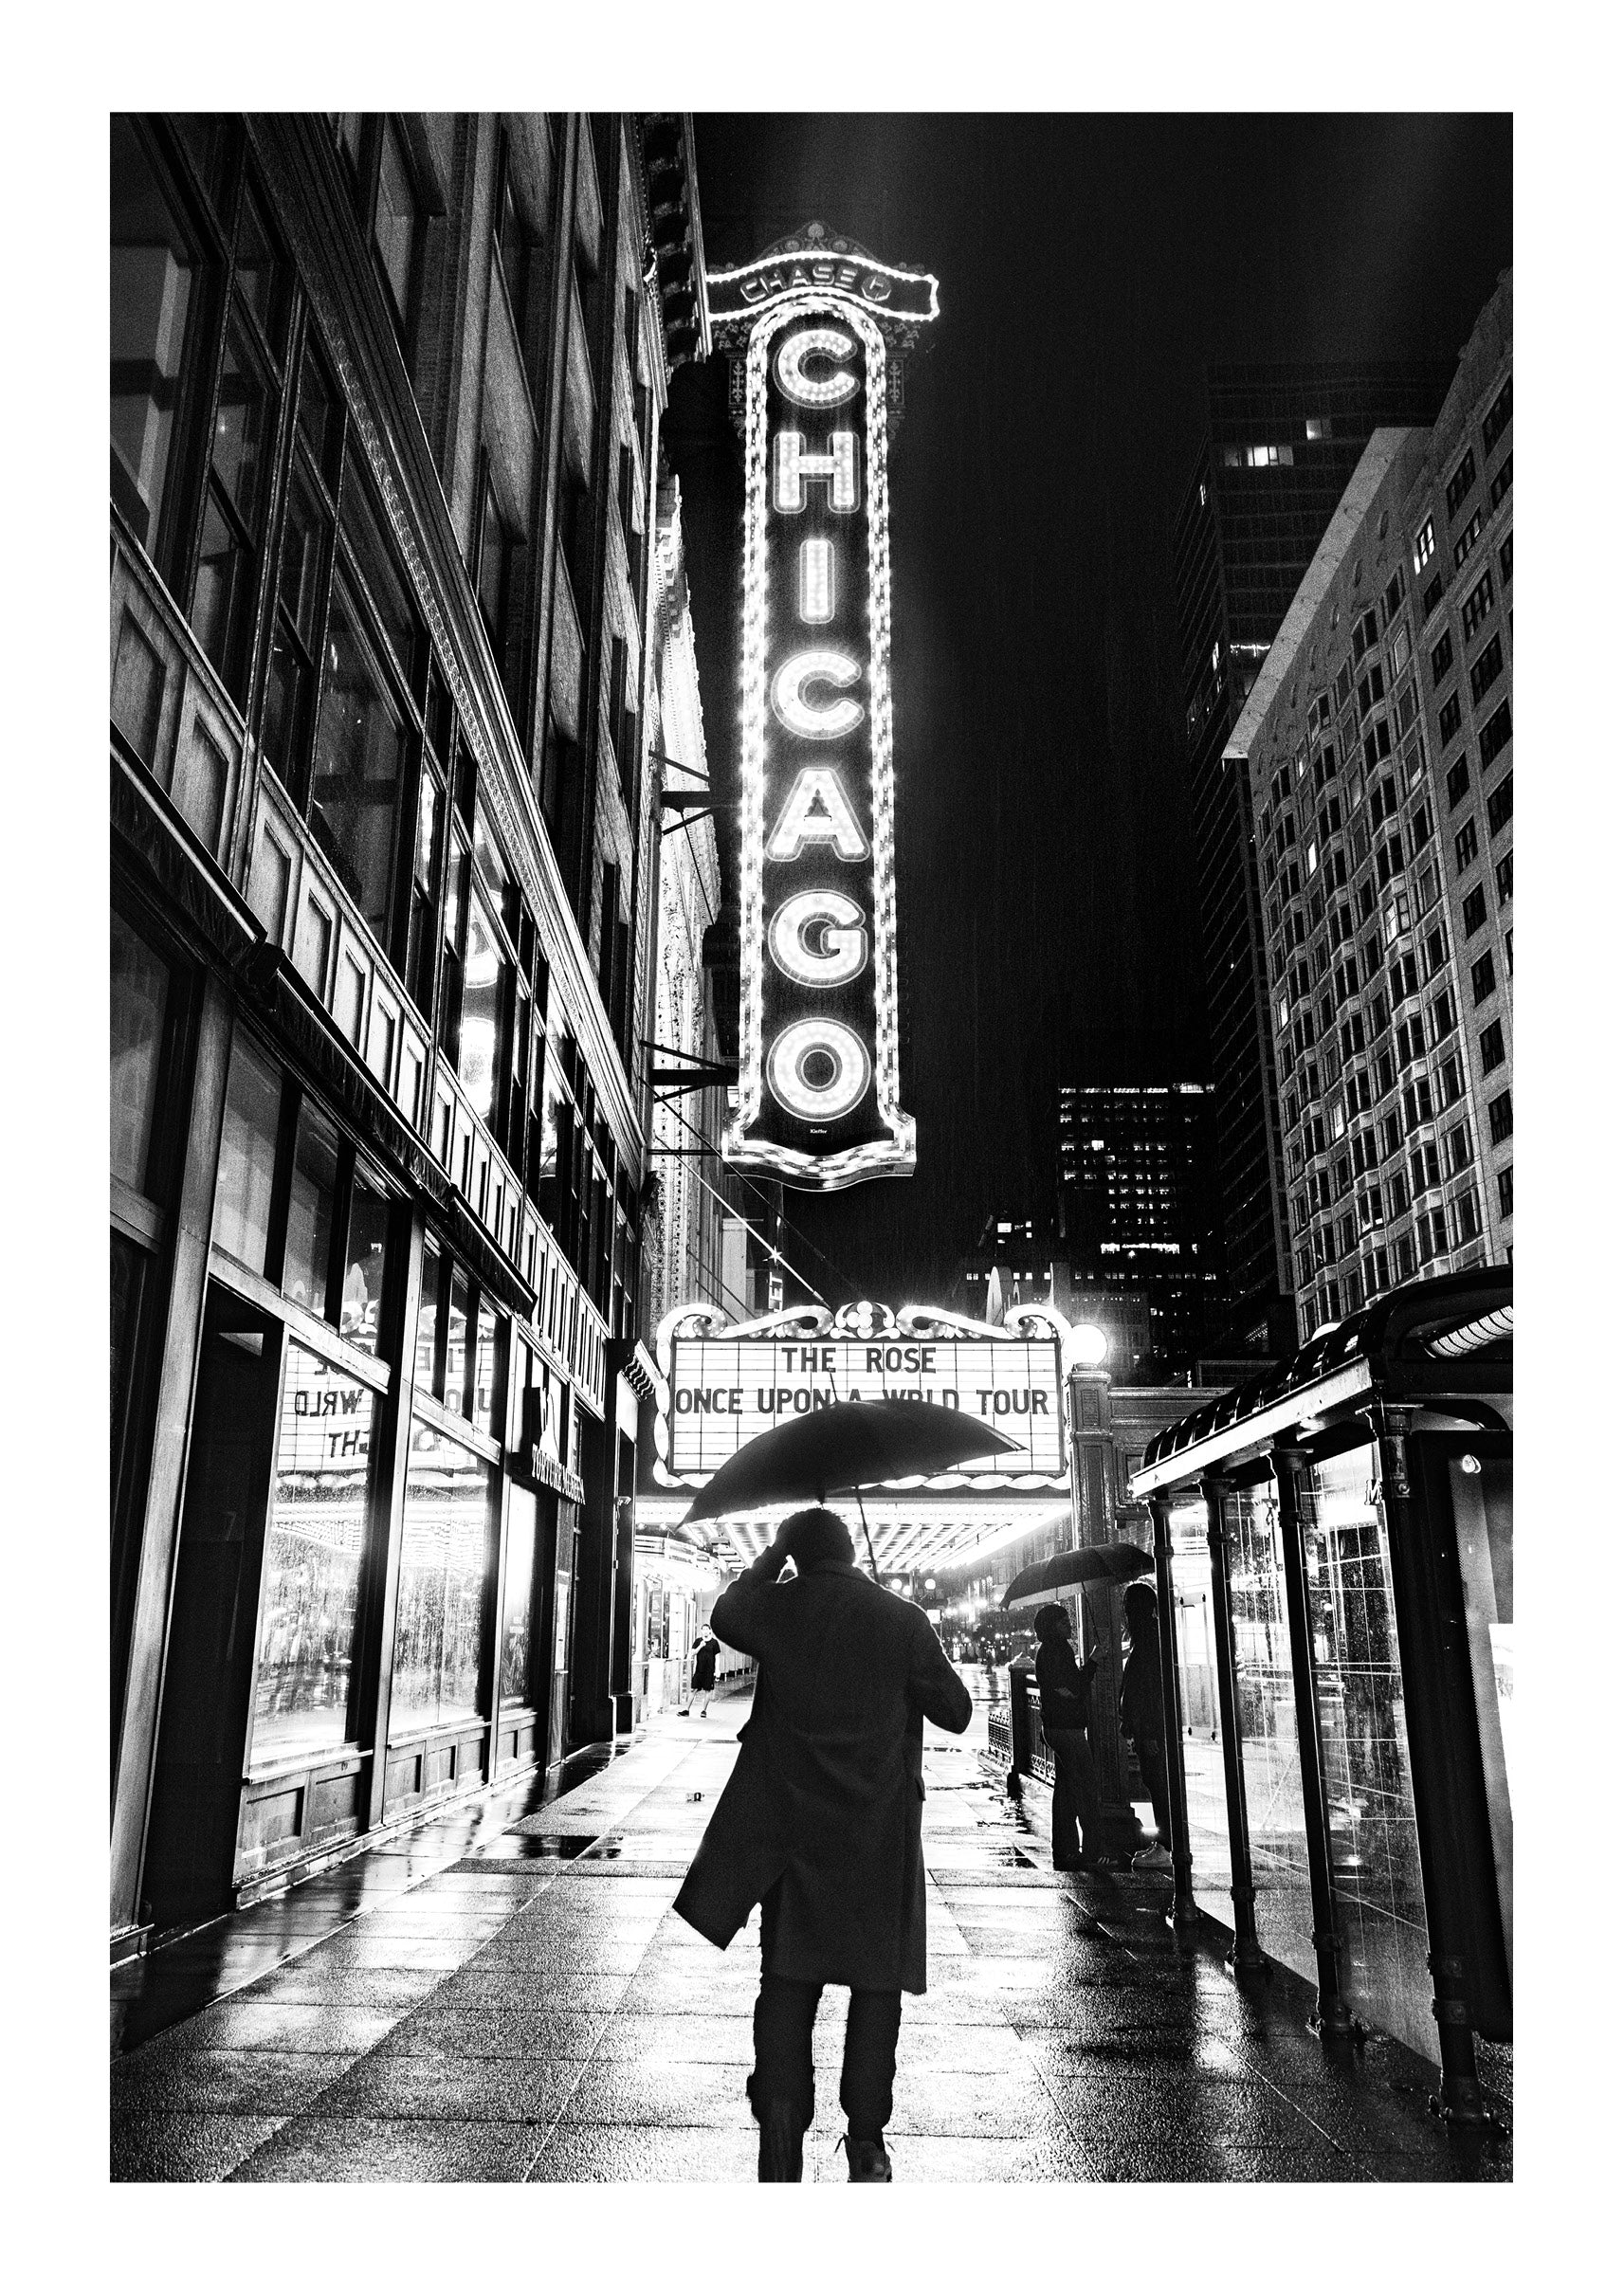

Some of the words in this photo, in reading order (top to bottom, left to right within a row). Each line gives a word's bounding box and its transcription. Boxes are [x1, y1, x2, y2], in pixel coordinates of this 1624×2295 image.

[739, 264, 858, 302] CHASE
[766, 329, 870, 1122] CHICAGO
[781, 1347, 836, 1374] THE
[866, 1347, 937, 1374] ROSE
[675, 1388, 744, 1415] ONCE
[757, 1388, 831, 1414] UPON
[976, 1389, 1049, 1415] TOUR
